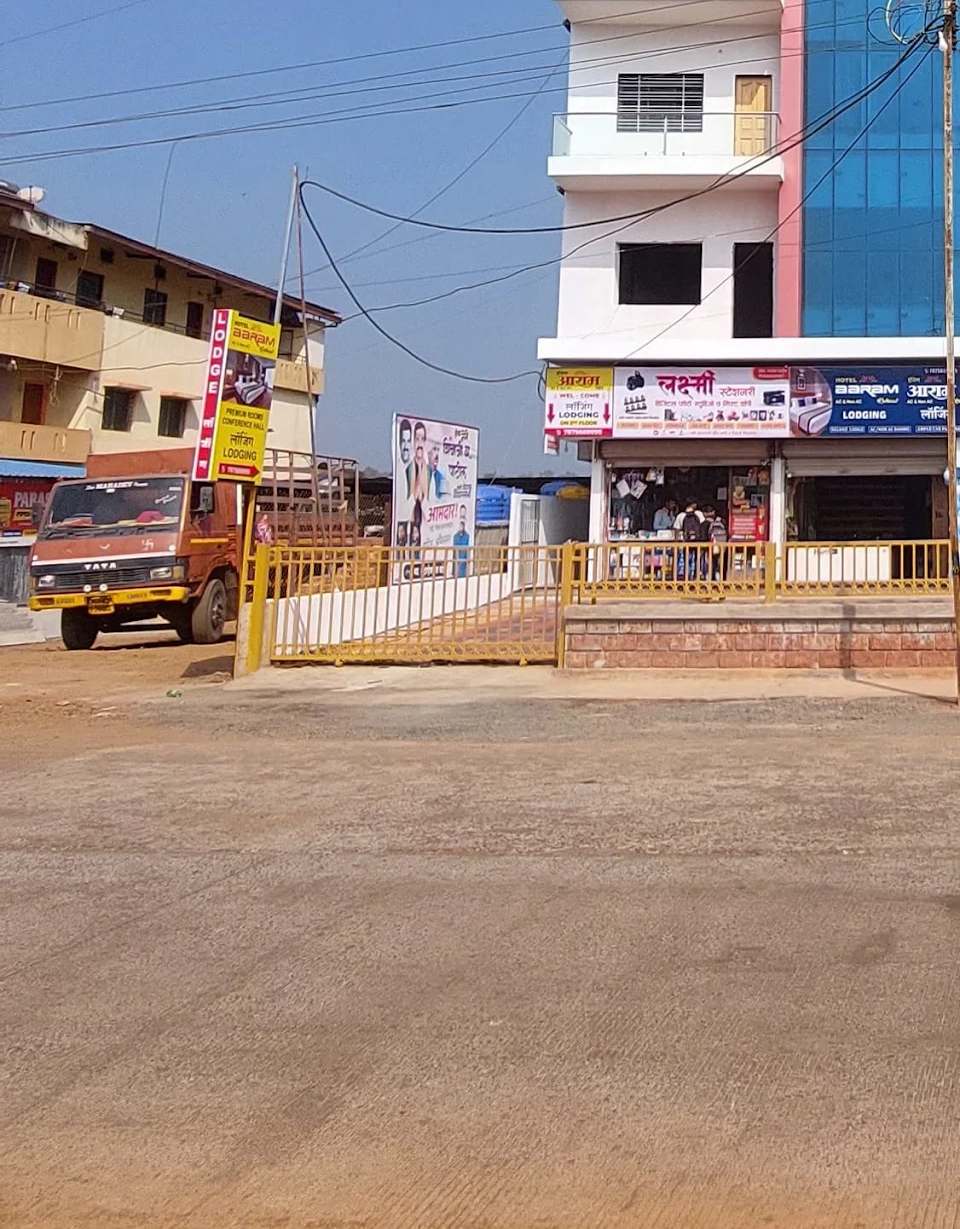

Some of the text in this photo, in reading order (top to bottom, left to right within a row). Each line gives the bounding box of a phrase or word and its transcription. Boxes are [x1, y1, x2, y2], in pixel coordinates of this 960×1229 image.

[208, 312, 226, 394] LODGE
[558, 374, 601, 388] आराम
[655, 369, 716, 400] लक्ष्मी
[719, 385, 756, 398] स्टेशनरी
[559, 411, 599, 419] LODGING
[842, 410, 887, 420] LODGING
[920, 406, 949, 420] लॉजिं
[222, 417, 253, 429] CONFERENCE
[223, 448, 257, 461] LODGING
[83, 562, 117, 570] TATA
